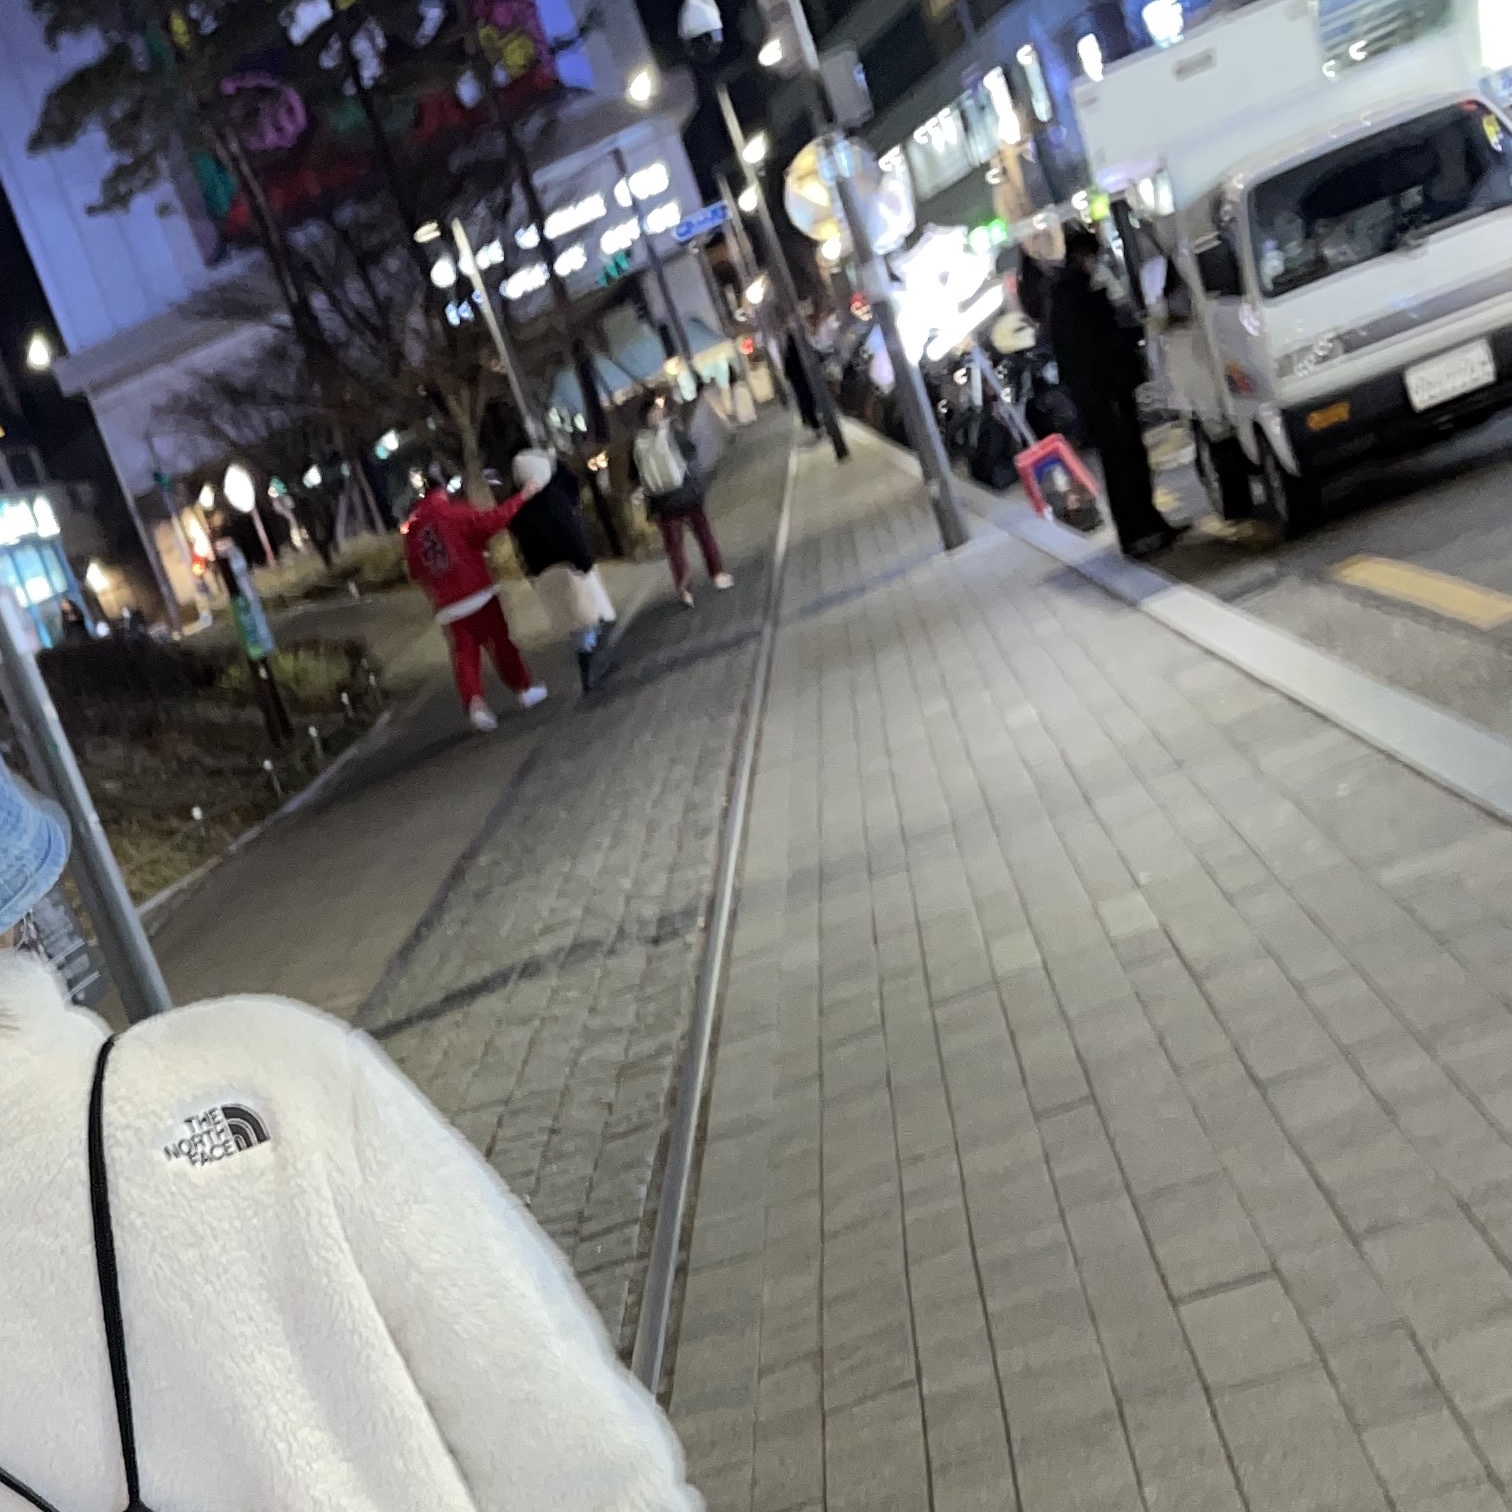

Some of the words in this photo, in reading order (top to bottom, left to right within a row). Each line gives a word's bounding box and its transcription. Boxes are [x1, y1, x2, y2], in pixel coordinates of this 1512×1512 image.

[184, 1106, 222, 1134] THE
[163, 1125, 226, 1163] NORTH
[186, 1138, 236, 1168] FACE
